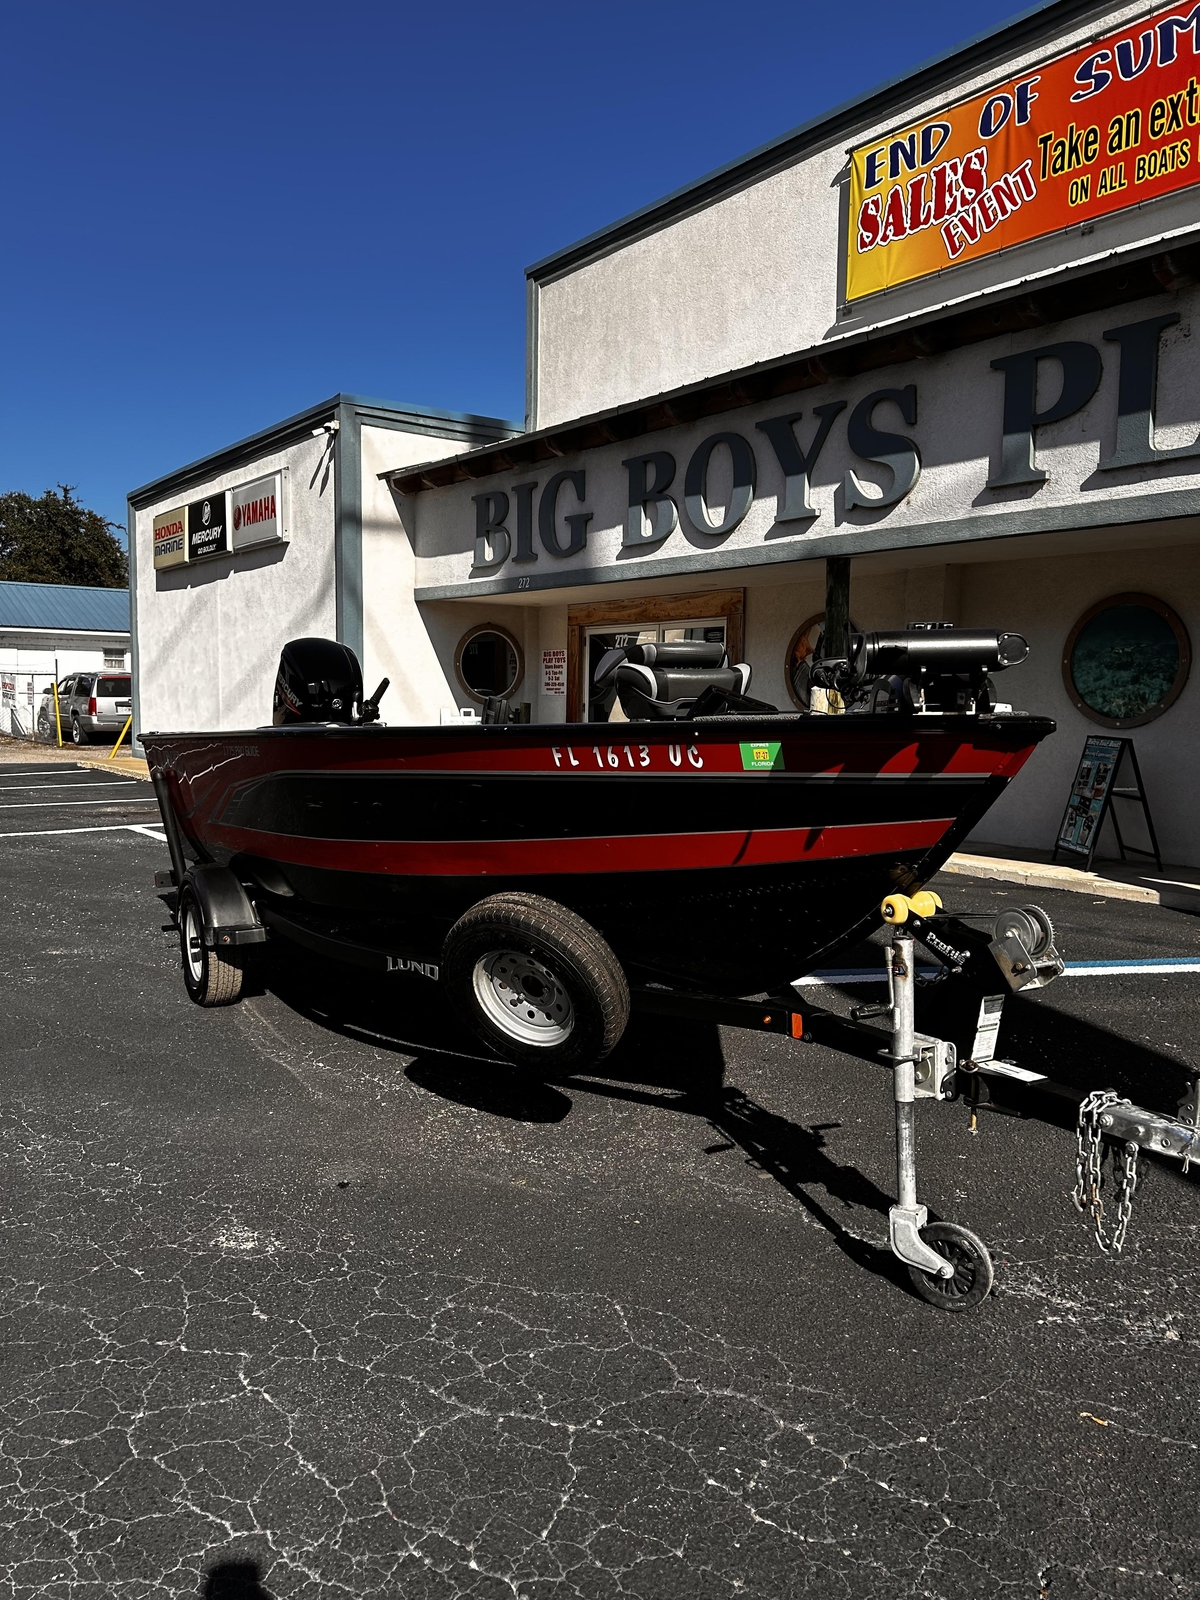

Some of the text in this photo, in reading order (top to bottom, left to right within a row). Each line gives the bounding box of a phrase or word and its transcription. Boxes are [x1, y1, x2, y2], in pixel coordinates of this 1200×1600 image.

[863, 121, 951, 190] END
[978, 75, 1042, 139] OF
[1038, 123, 1100, 182] Take
[1108, 110, 1142, 156] an
[1068, 139, 1191, 206] ON ALL BOATS
[858, 146, 988, 254] SALES
[941, 159, 1036, 260] EVENT
[471, 469, 595, 569] BIG
[620, 385, 922, 547] BOYS
[241, 494, 276, 527] YAMAHA
[154, 520, 184, 541] HONDA
[154, 537, 184, 556] MARINE
[191, 524, 223, 545] MERCURY
[518, 577, 530, 589] 272
[614, 633, 629, 649] 272
[278, 672, 304, 708] ERCURY
[551, 744, 704, 769] FL 1613 UC
[926, 931, 966, 964] Profile
[386, 955, 439, 981] LUND
